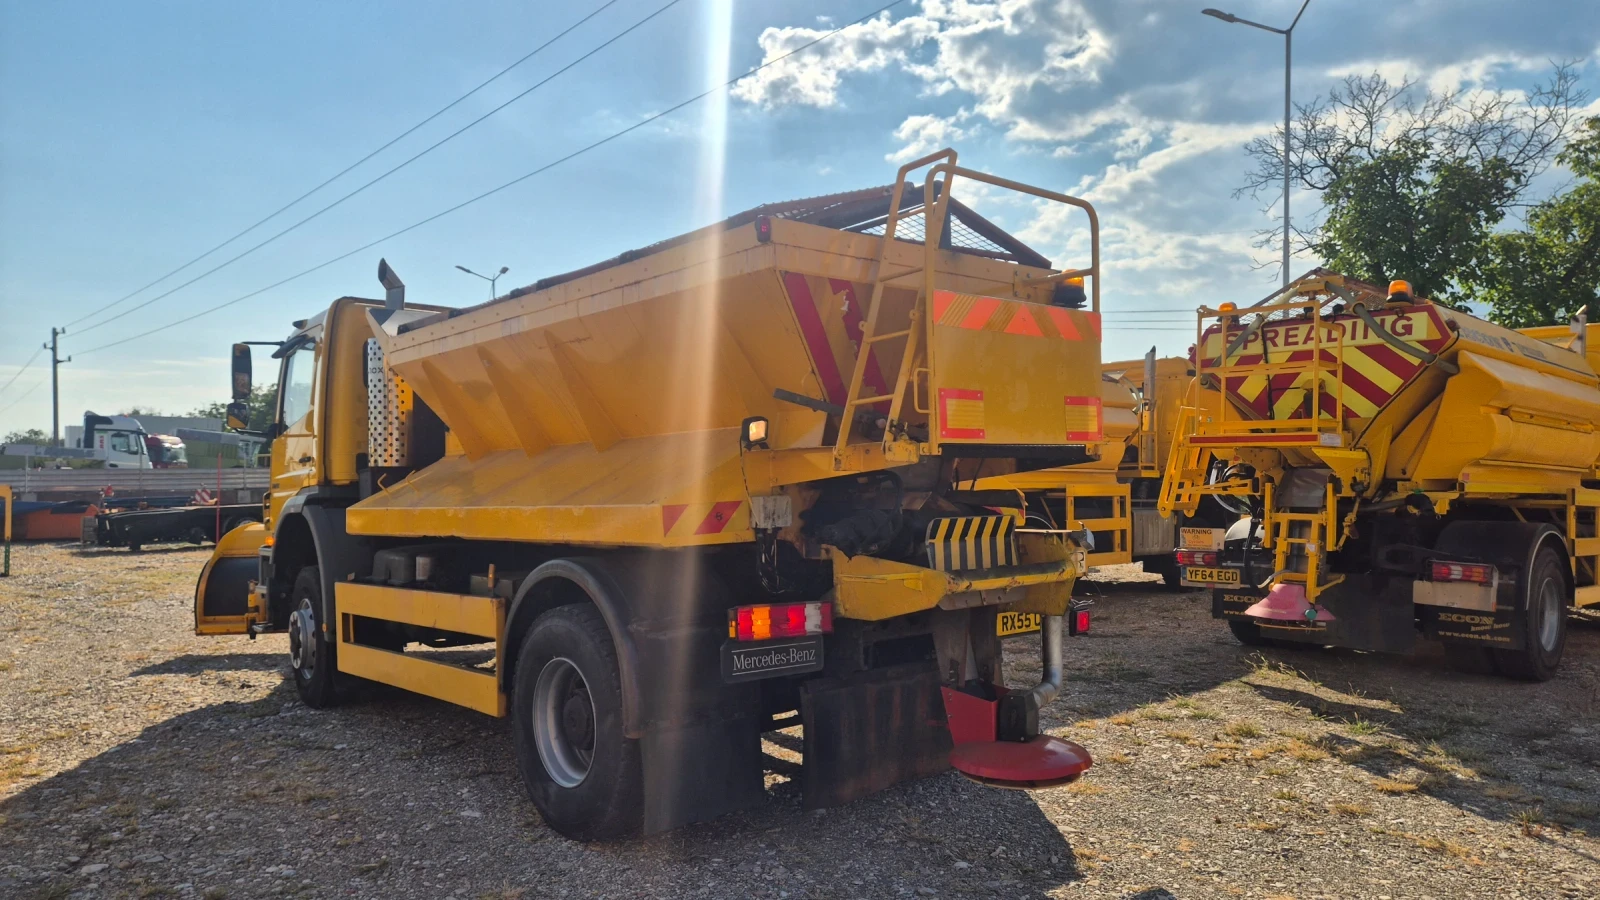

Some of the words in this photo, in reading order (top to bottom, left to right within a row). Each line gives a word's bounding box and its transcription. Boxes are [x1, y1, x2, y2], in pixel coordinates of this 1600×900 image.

[1188, 569, 1214, 580] YF64
[1217, 571, 1238, 582] EGD
[1002, 613, 1031, 632] RX55
[1438, 612, 1495, 624] ECON
[733, 648, 816, 671] Mercedes-Benz
